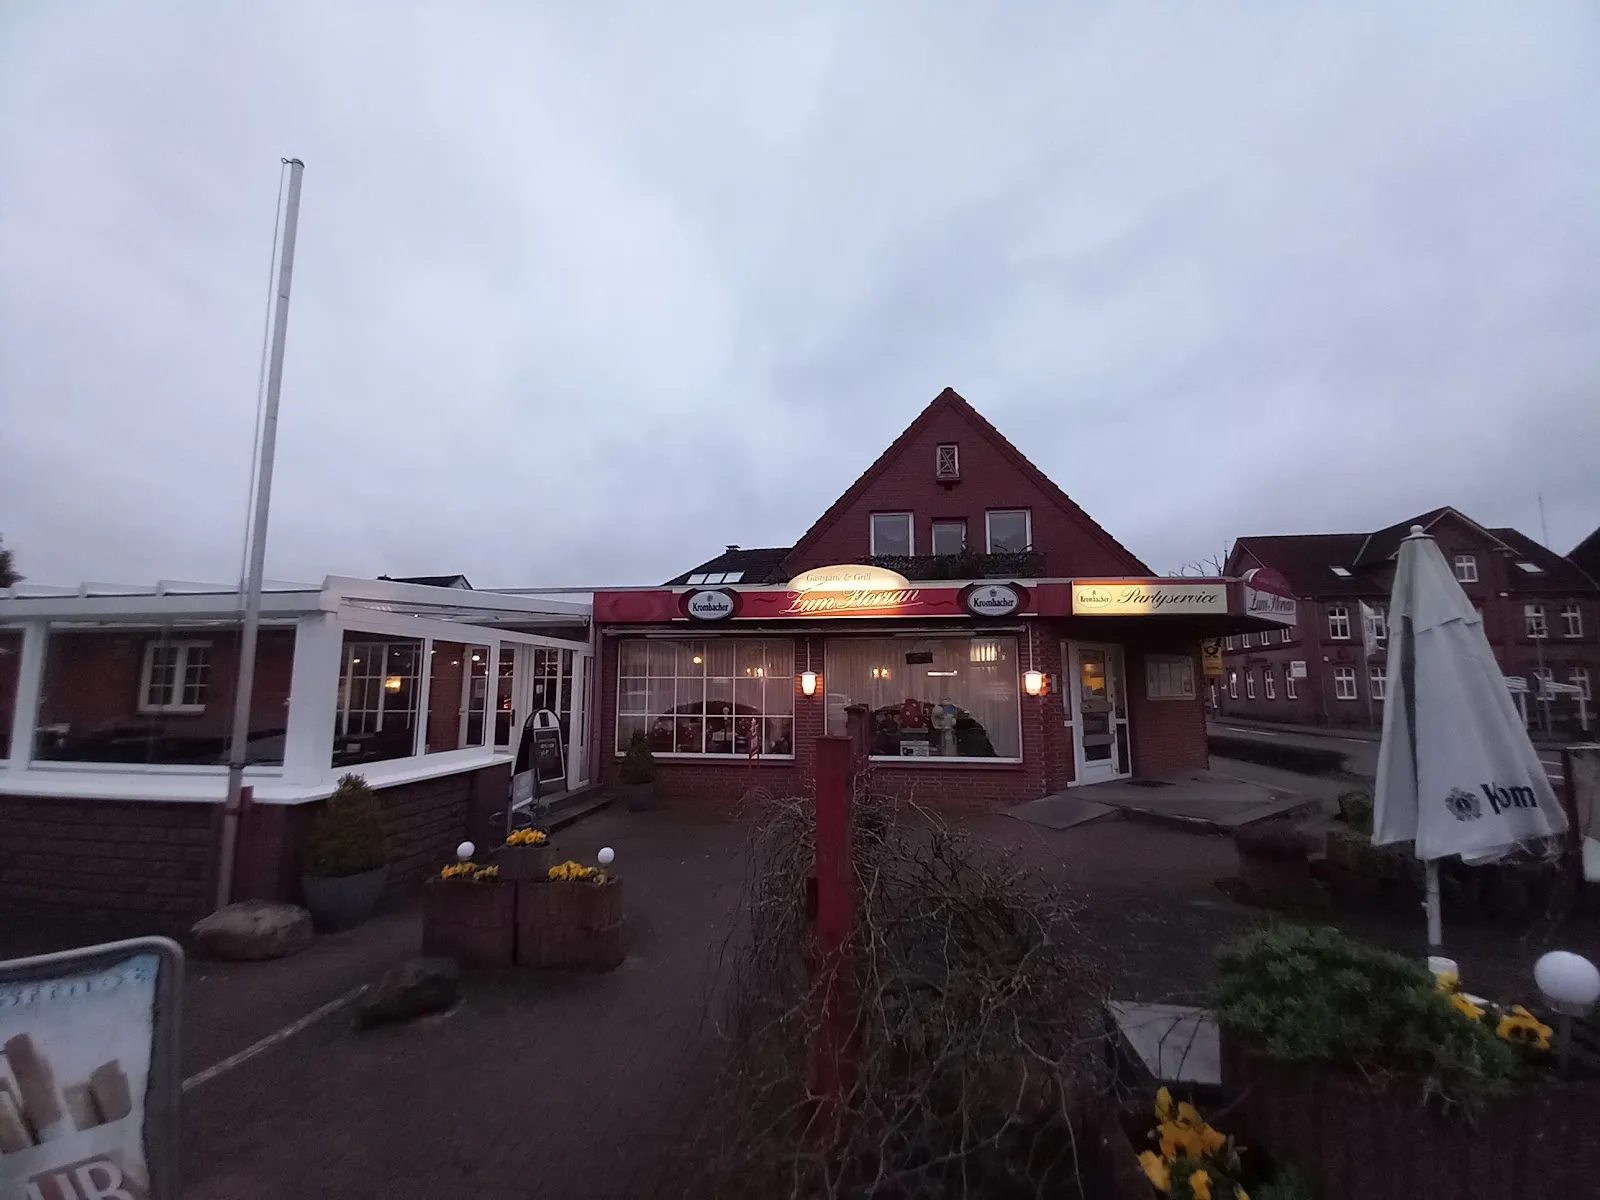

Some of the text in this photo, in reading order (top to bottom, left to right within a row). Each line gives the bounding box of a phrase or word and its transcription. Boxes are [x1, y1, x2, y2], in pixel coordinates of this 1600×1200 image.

[844, 573, 852, 581] &
[853, 572, 871, 581] Grill
[780, 588, 836, 612] Zum
[973, 597, 1014, 608] Krombacher
[1117, 587, 1219, 609] Partyservice
[692, 602, 729, 612] Krombacher
